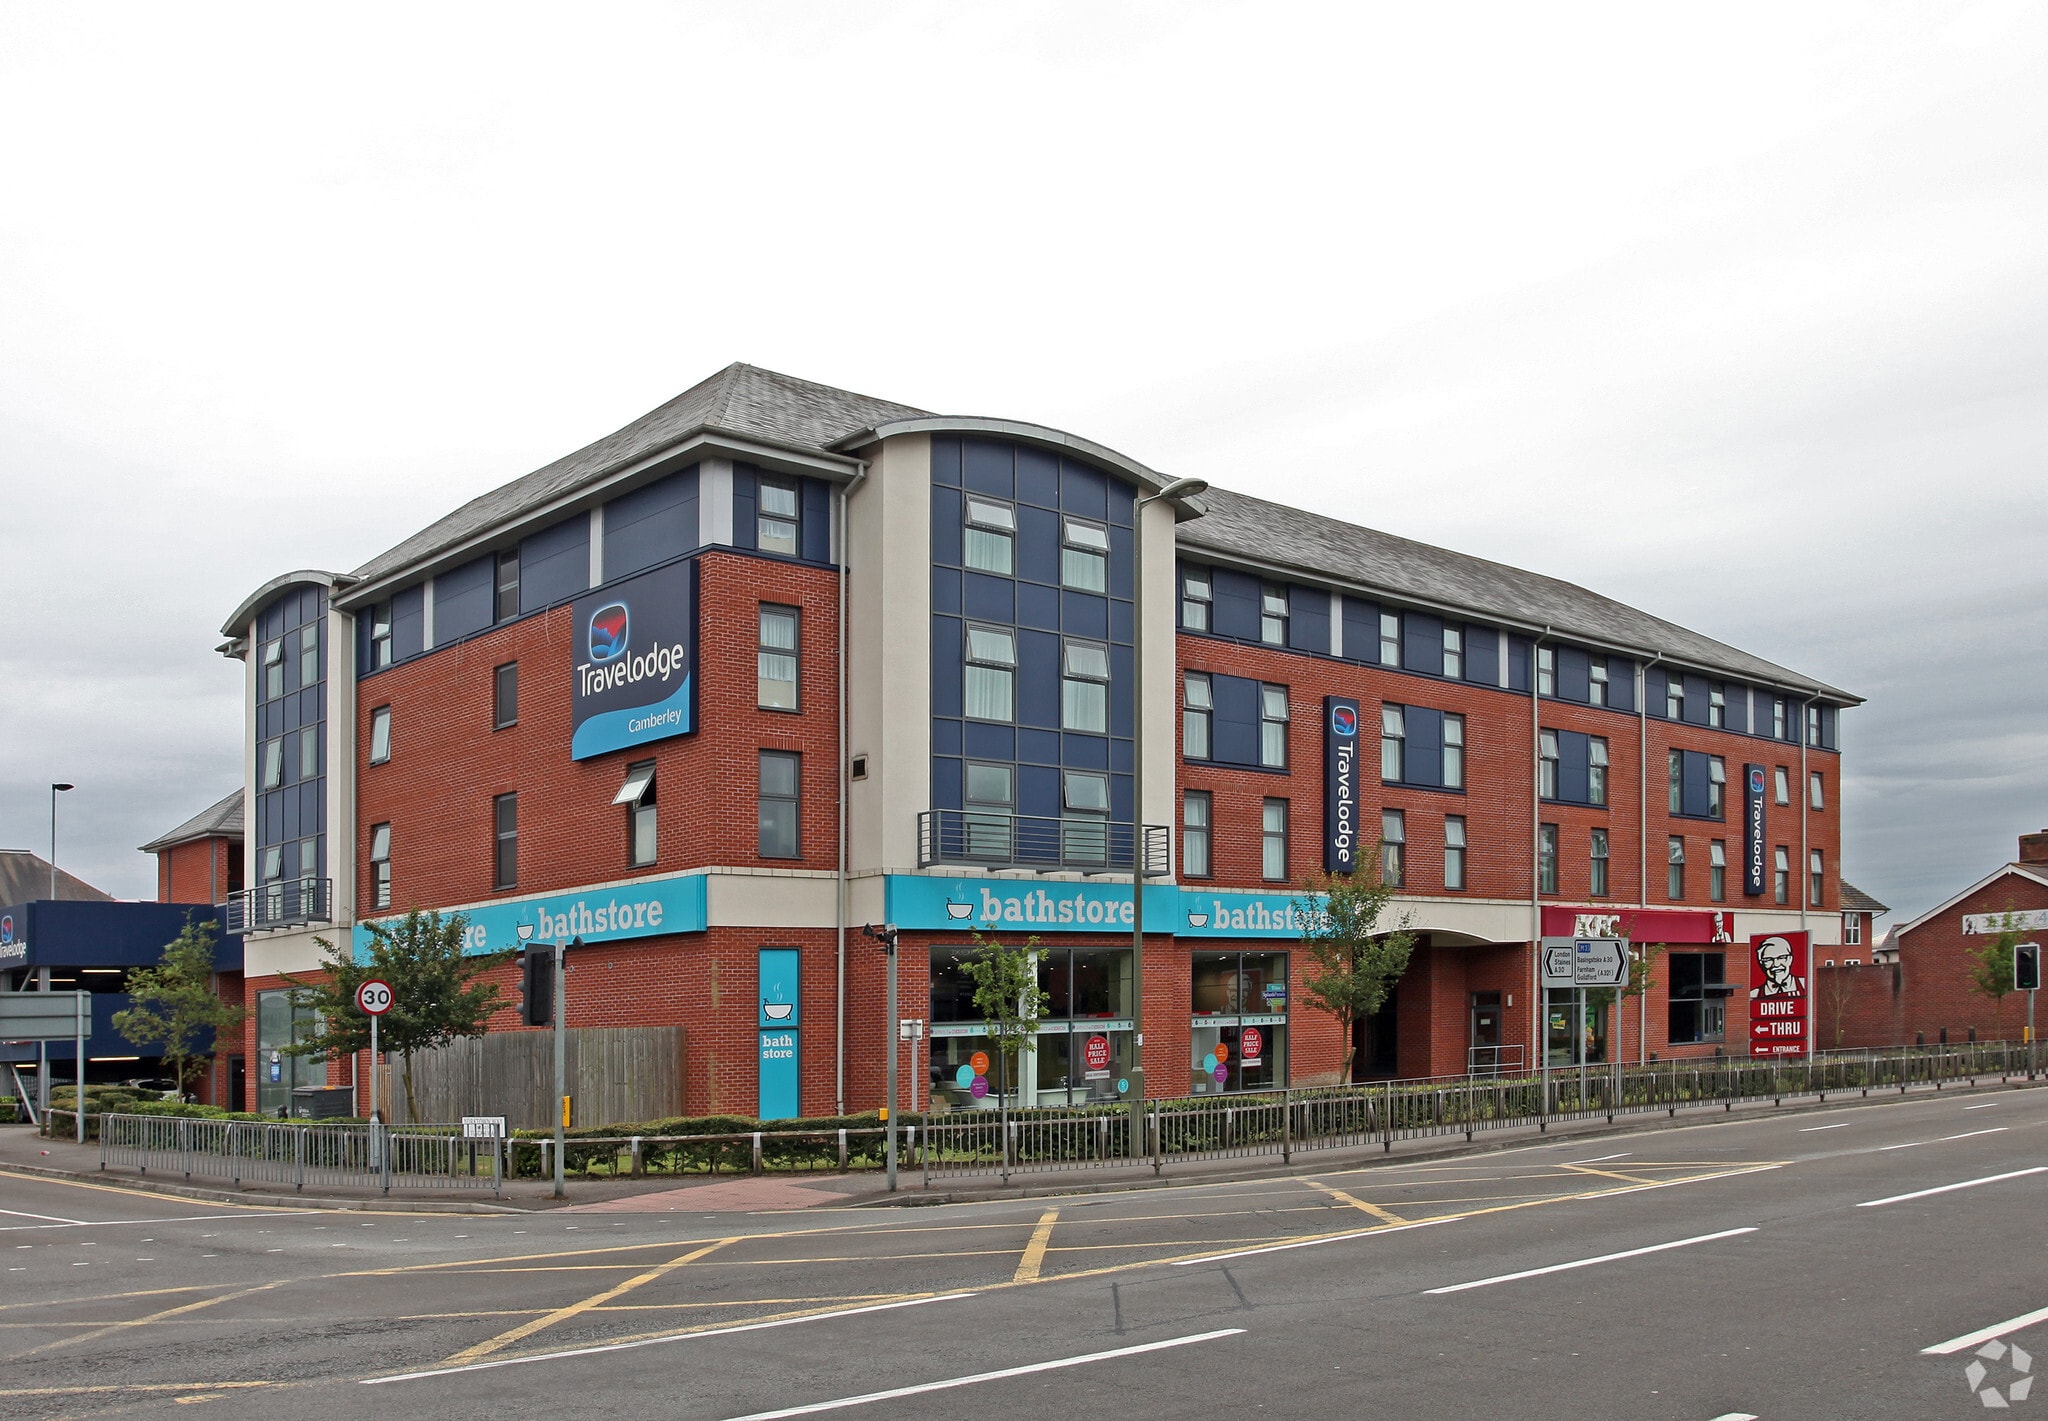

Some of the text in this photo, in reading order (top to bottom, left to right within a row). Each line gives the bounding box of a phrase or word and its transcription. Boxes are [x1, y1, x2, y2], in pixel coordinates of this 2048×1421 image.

[577, 641, 684, 697] Travelodge
[628, 708, 682, 733] Camberley
[1335, 741, 1354, 863] Travelodge
[1752, 796, 1763, 887] Travelodge
[980, 888, 1135, 924] bathstore
[538, 898, 663, 940] bathstore
[363, 989, 390, 1005] 30
[1760, 1001, 1794, 1016] DRIVE
[1769, 1021, 1801, 1036] THRU
[762, 1034, 793, 1047] bath
[1772, 1045, 1801, 1053] ENTRANCE
[762, 1048, 793, 1059] store
